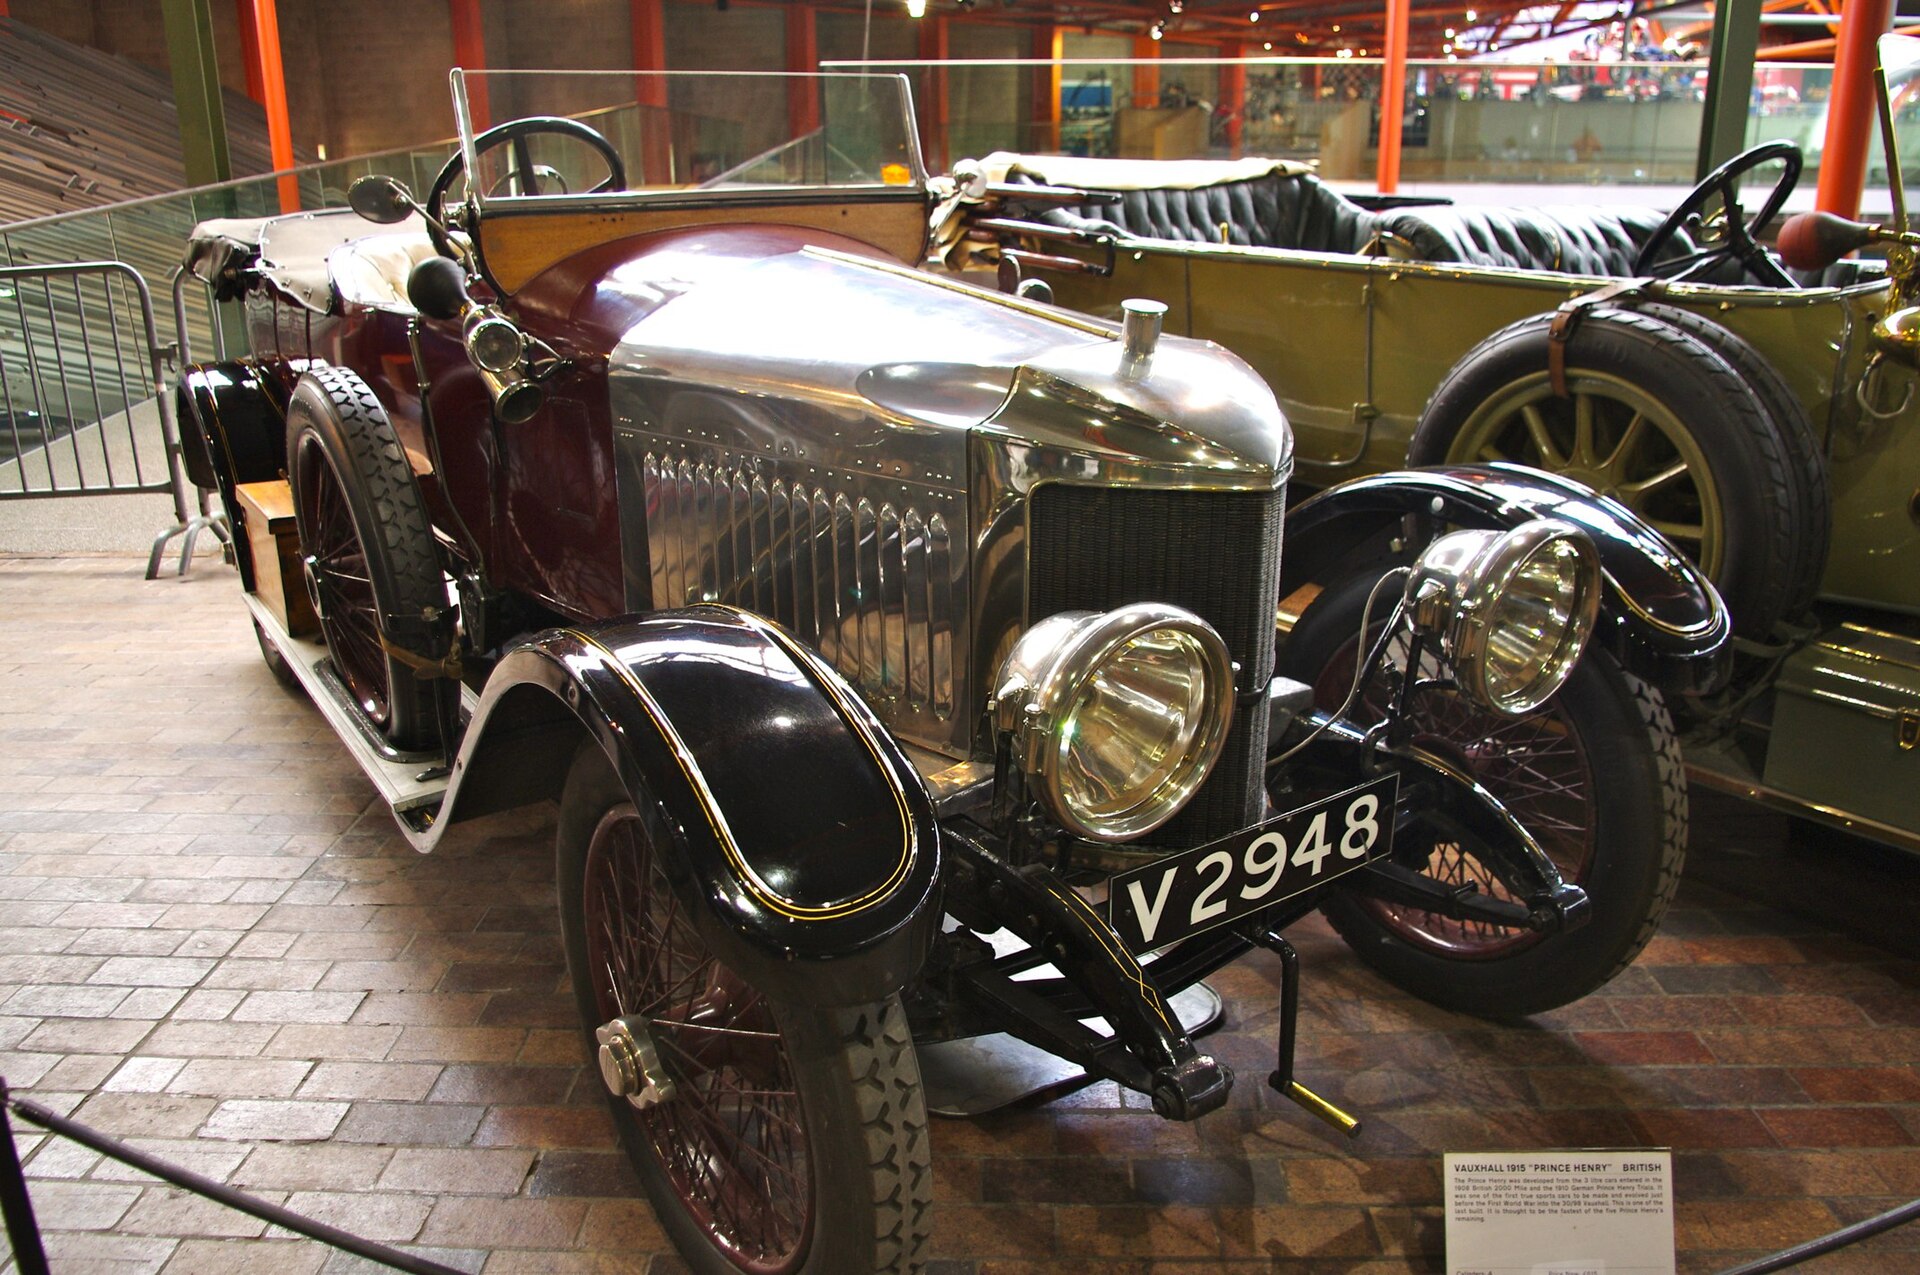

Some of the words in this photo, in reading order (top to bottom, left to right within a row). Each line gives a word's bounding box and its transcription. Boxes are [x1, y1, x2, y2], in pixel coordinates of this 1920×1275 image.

[1455, 1164, 1504, 1172] VAUXHALL
[1507, 1164, 1526, 1172] 1915
[1528, 1164, 1571, 1172] "PRINCE
[1574, 1164, 1612, 1172] HENRY"
[1623, 1164, 1661, 1172] BRITISH
